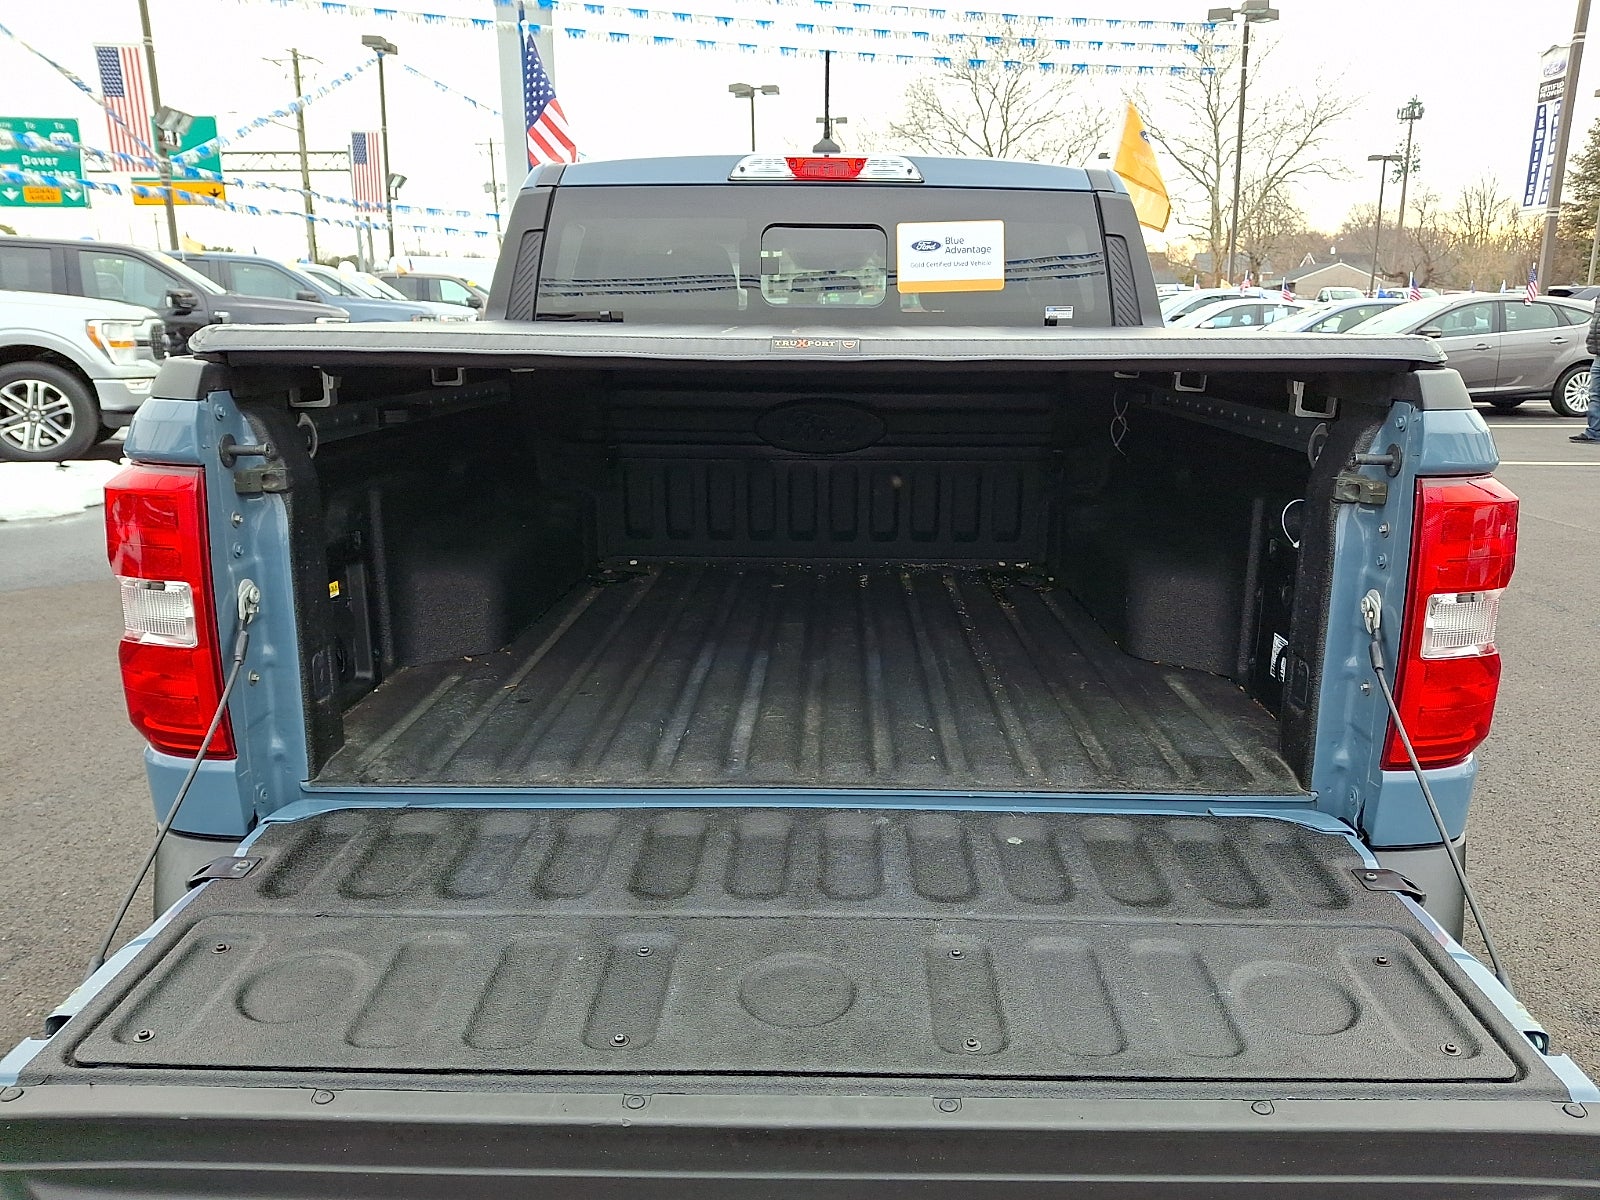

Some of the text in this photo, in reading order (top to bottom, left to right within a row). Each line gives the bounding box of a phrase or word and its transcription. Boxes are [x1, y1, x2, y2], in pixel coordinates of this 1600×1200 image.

[21, 154, 59, 166] Dover
[945, 236, 965, 245] Blue
[915, 241, 938, 251] Ford
[945, 246, 992, 254] Advantage
[910, 261, 925, 269] Gold
[926, 260, 952, 268] Certified
[775, 339, 836, 349] TRUXPORT
